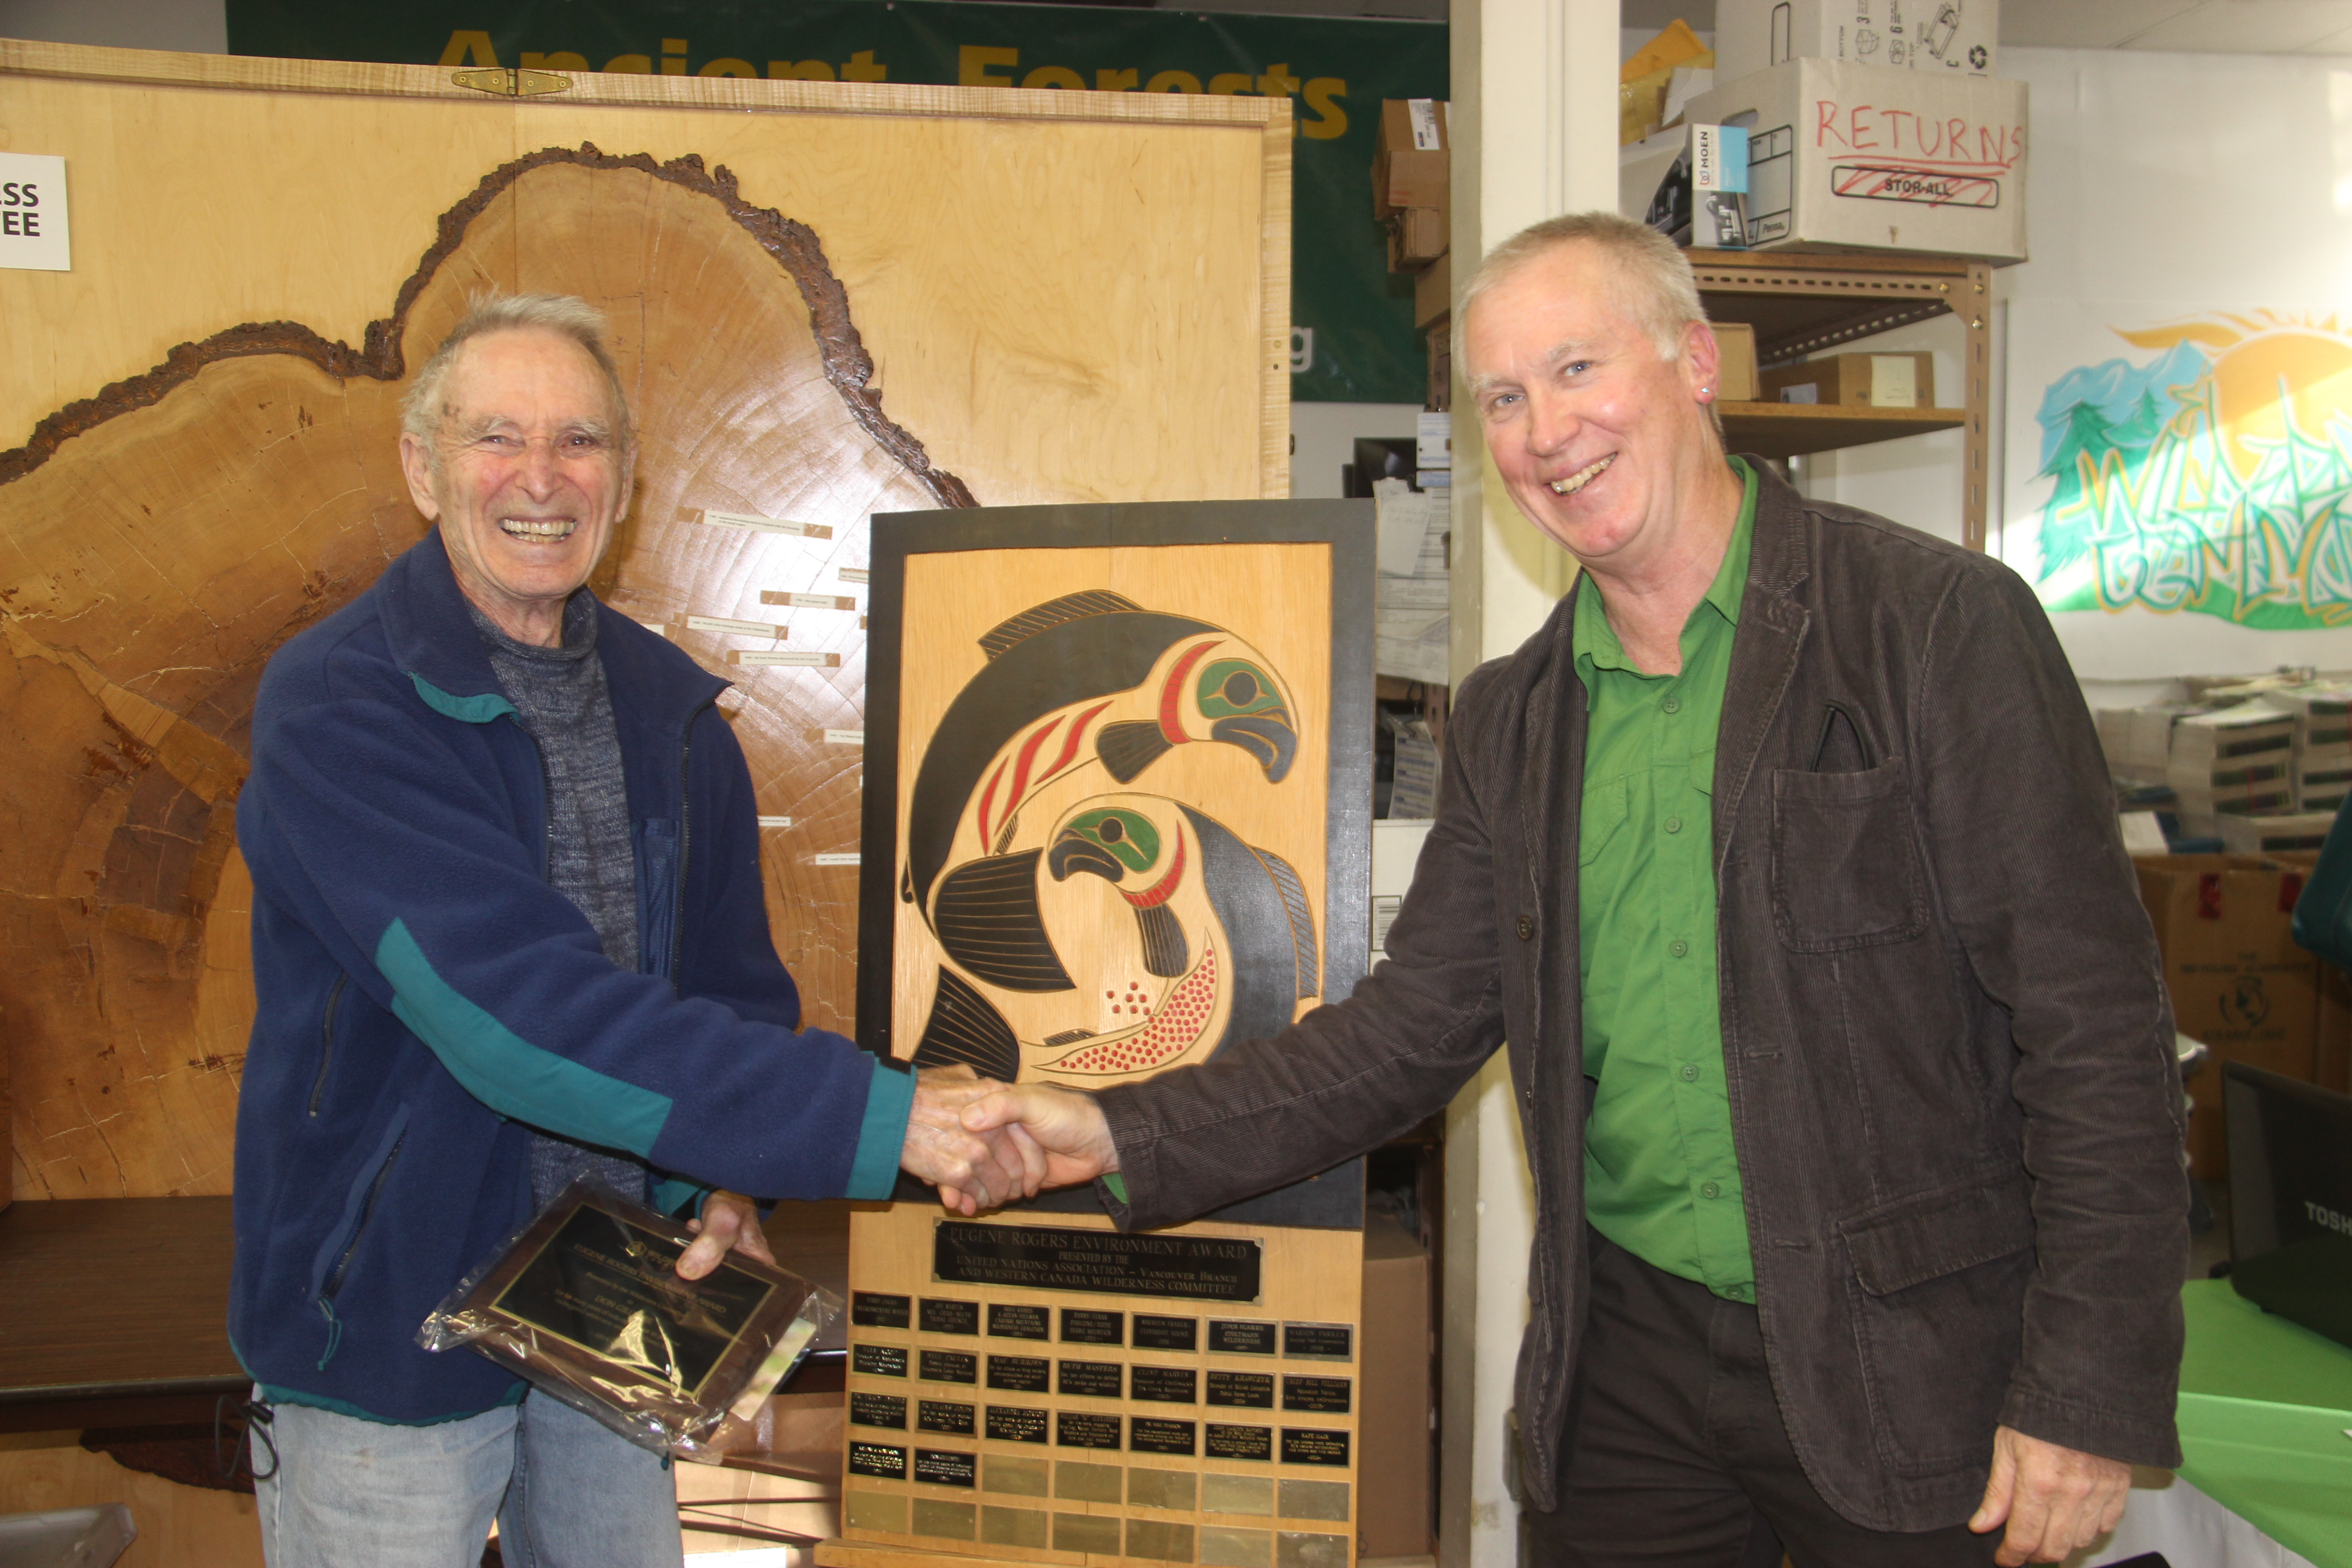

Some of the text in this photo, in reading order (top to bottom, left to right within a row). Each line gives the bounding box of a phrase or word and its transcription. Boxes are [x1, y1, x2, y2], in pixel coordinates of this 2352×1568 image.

[1816, 100, 2023, 166] RETURNS
[1700, 131, 1709, 168] MOEN
[0, 182, 39, 207] SS
[1885, 178, 1953, 197] STOR-ALL
[0, 211, 41, 237] EE
[2304, 1200, 2352, 1238] TOSH
[950, 1227, 1247, 1259] EUGENE ROGERS ENVIRONMENT AWARD
[956, 1255, 996, 1266] UNITED
[1000, 1258, 1049, 1271] NATIONS
[1052, 1262, 1125, 1276] ASSOCIATION
[1058, 1251, 1129, 1265] PRESENTED BY THE
[958, 1267, 1236, 1294] AND WESTERN CANADA WILDERNESS COMMITTEE
